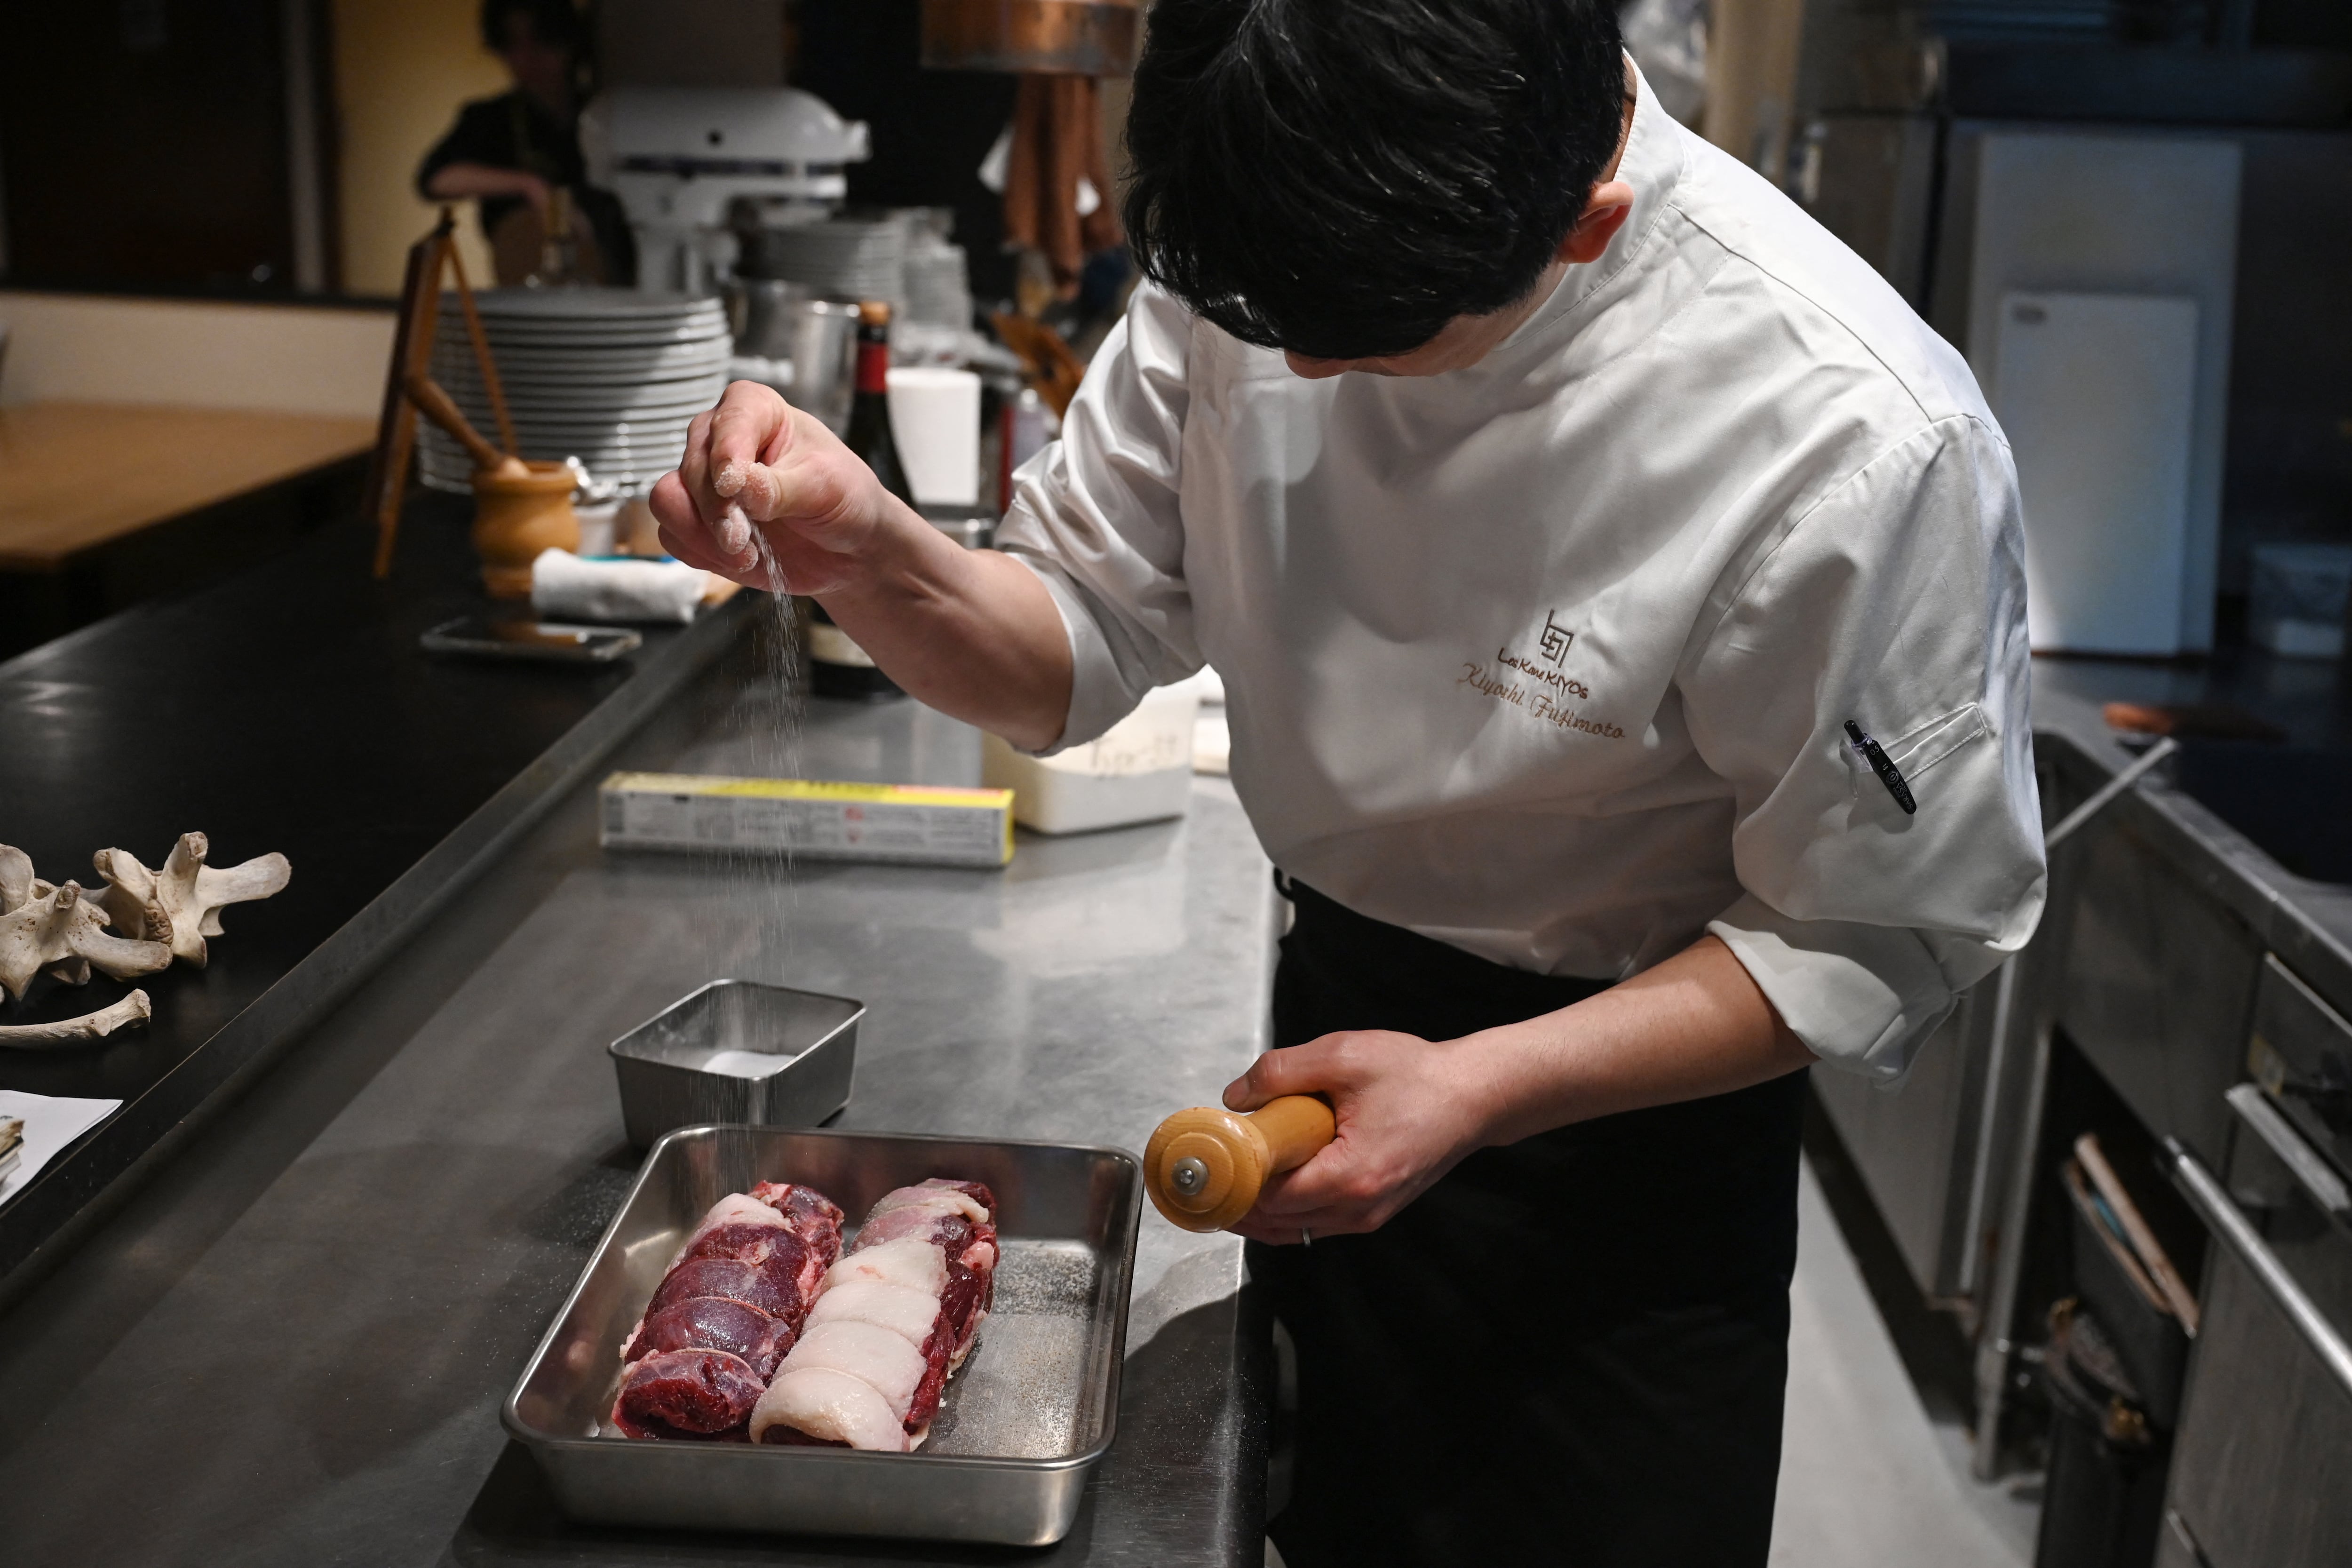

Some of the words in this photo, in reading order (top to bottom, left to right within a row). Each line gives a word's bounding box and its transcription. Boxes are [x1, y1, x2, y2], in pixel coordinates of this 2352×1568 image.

[1457, 663, 1525, 705] Kiyoshi
[1530, 694, 1625, 739] Fujimoto
[1896, 782, 1913, 809] SARASA
